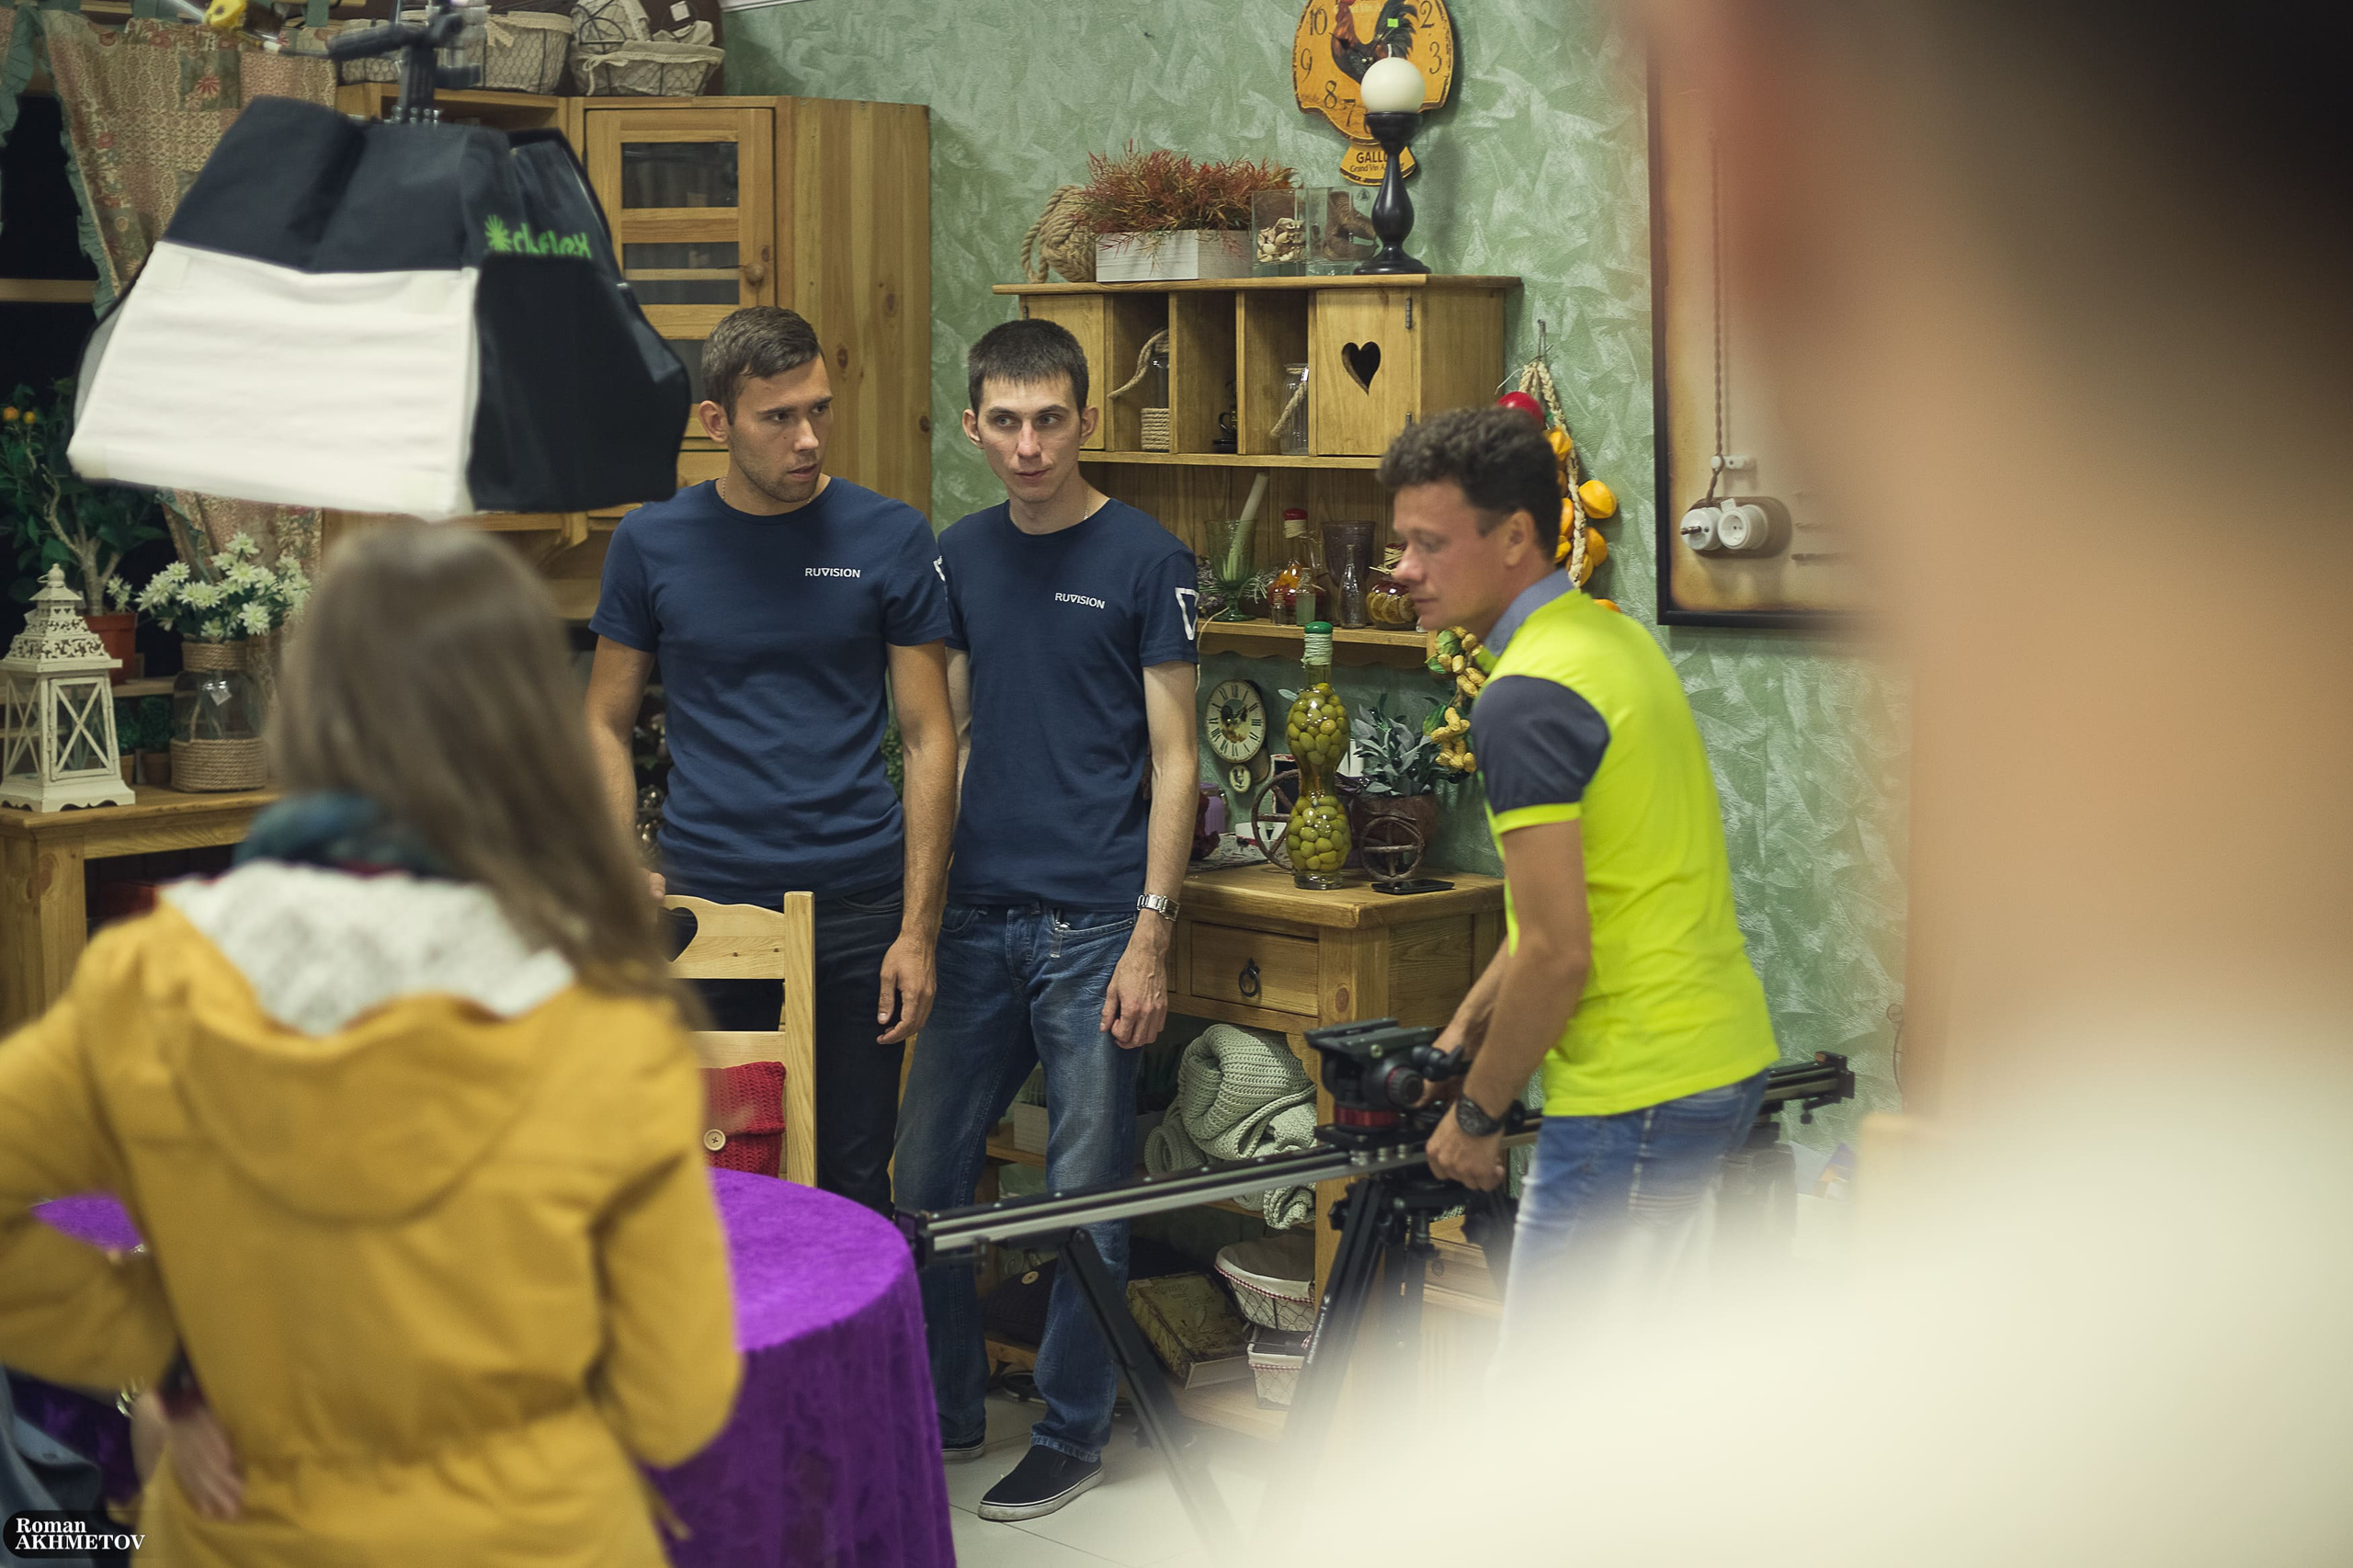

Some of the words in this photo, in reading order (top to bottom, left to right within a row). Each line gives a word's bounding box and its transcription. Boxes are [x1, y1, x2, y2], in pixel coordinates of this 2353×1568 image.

[1310, 8, 1327, 35] 10
[1419, 0, 1435, 28] 2
[1301, 48, 1313, 83] 9
[1429, 41, 1442, 74] 3
[1324, 80, 1337, 108] 8
[1343, 98, 1356, 127] 7
[1349, 165, 1369, 173] Grand
[804, 567, 861, 578] RUVISION
[1054, 592, 1106, 609] RUVISION
